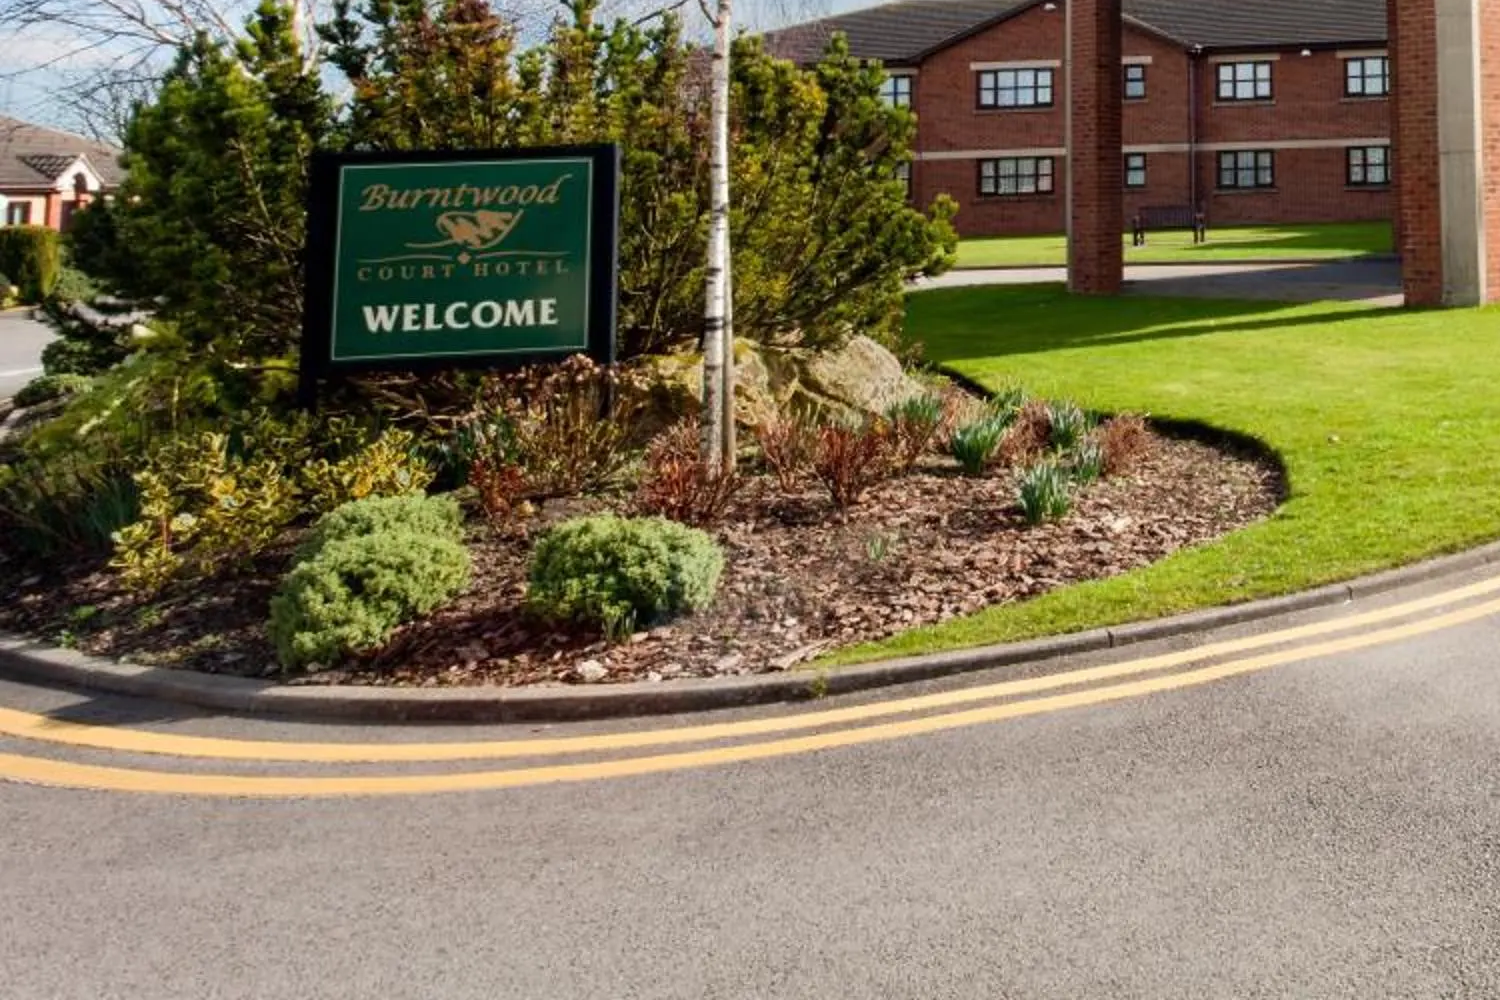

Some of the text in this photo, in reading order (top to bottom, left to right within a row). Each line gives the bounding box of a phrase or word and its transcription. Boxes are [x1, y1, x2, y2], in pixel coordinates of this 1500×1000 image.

[357, 173, 573, 211] Burntwood
[357, 259, 570, 281] COURT HOTEL
[361, 298, 559, 333] WELCOME
